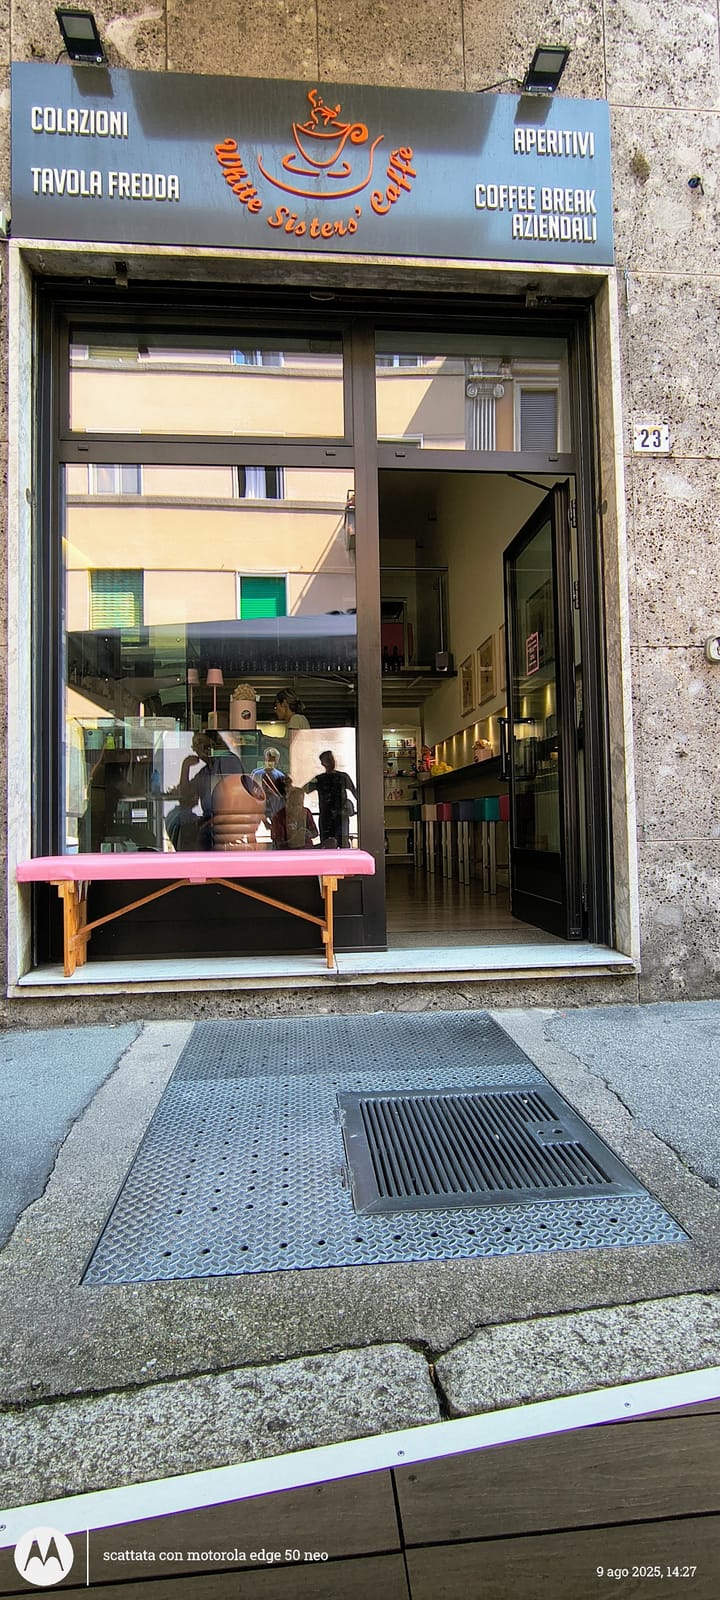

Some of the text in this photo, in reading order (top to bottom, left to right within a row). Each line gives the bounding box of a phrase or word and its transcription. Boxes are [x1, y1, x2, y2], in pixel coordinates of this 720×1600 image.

[31, 106, 129, 138] COLAZIONI
[513, 127, 595, 158] APERITIVI
[31, 167, 180, 201] TAVOLA FREDDA
[214, 138, 263, 213] White
[475, 183, 597, 215] COFFEE BREAK
[512, 213, 597, 242] AZIENDALI
[640, 428, 661, 448] 23
